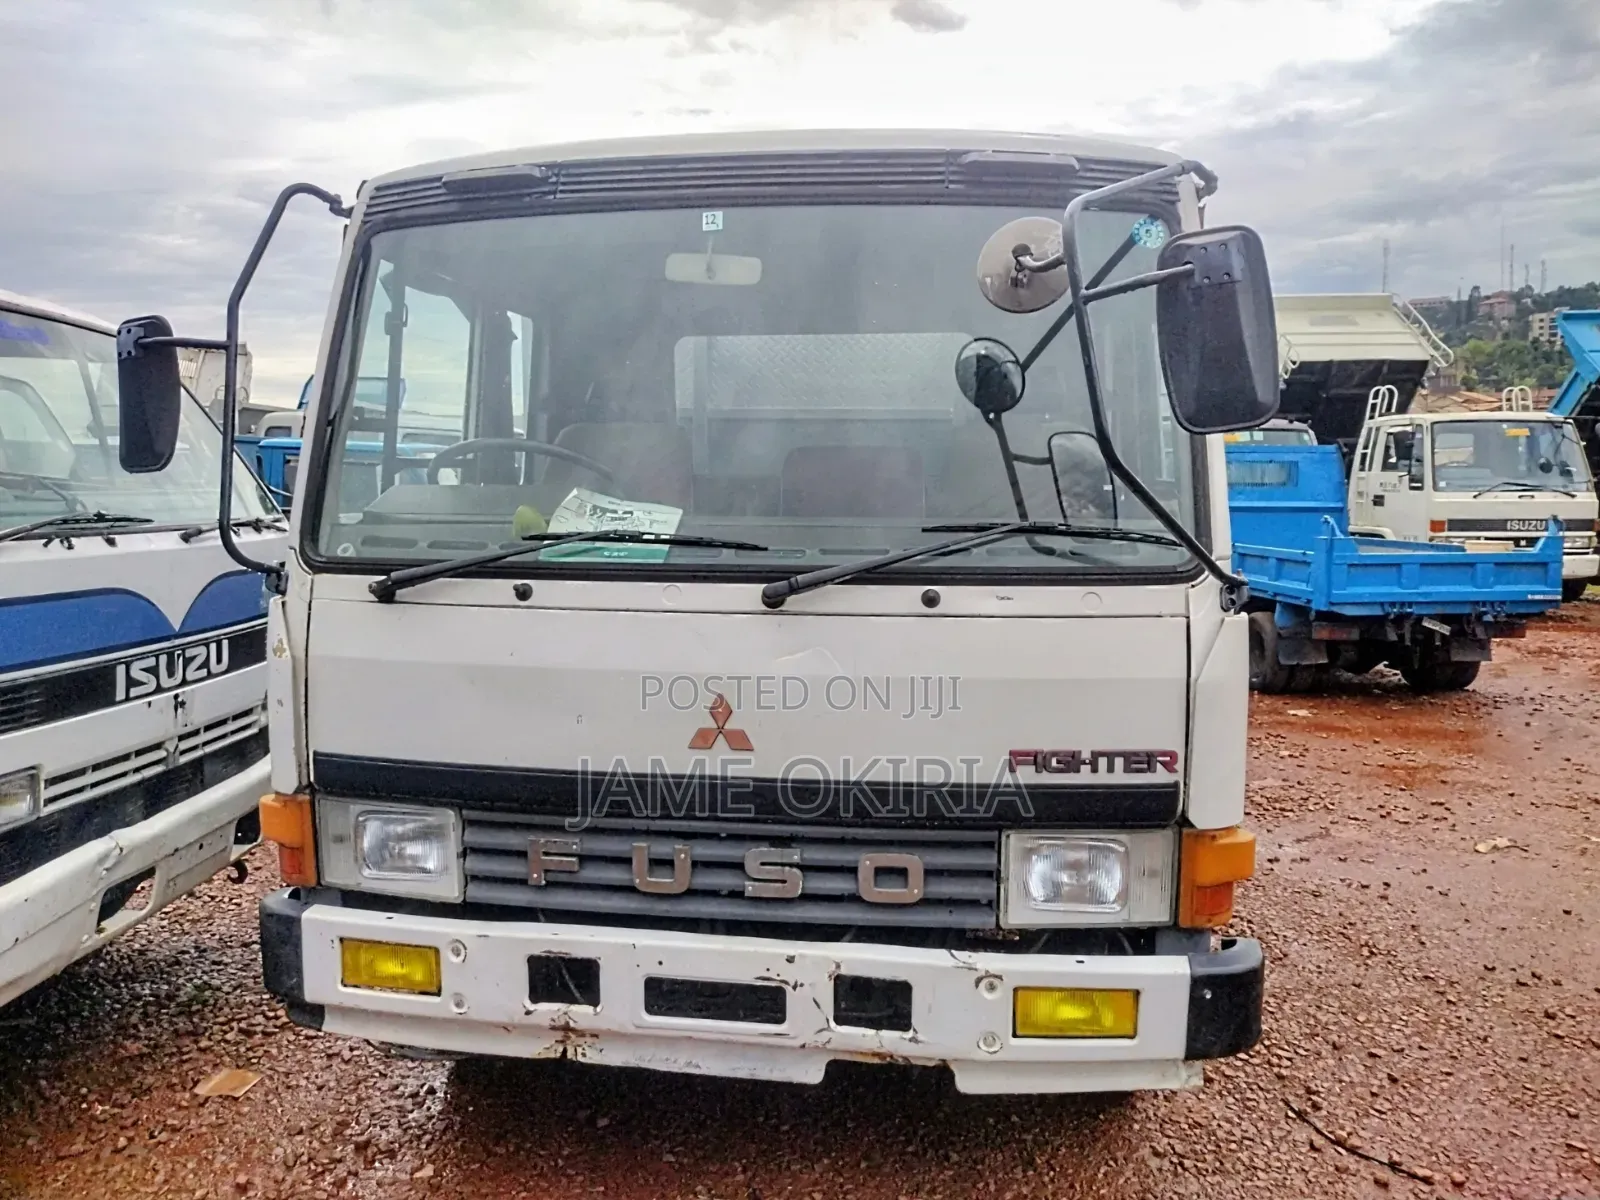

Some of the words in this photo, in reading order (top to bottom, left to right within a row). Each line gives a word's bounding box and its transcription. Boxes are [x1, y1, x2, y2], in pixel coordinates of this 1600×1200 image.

[1506, 519, 1546, 531] ISUZU
[115, 638, 229, 702] ISUZU
[1008, 749, 1179, 774] FIGHTER
[527, 837, 925, 904] FUSO
